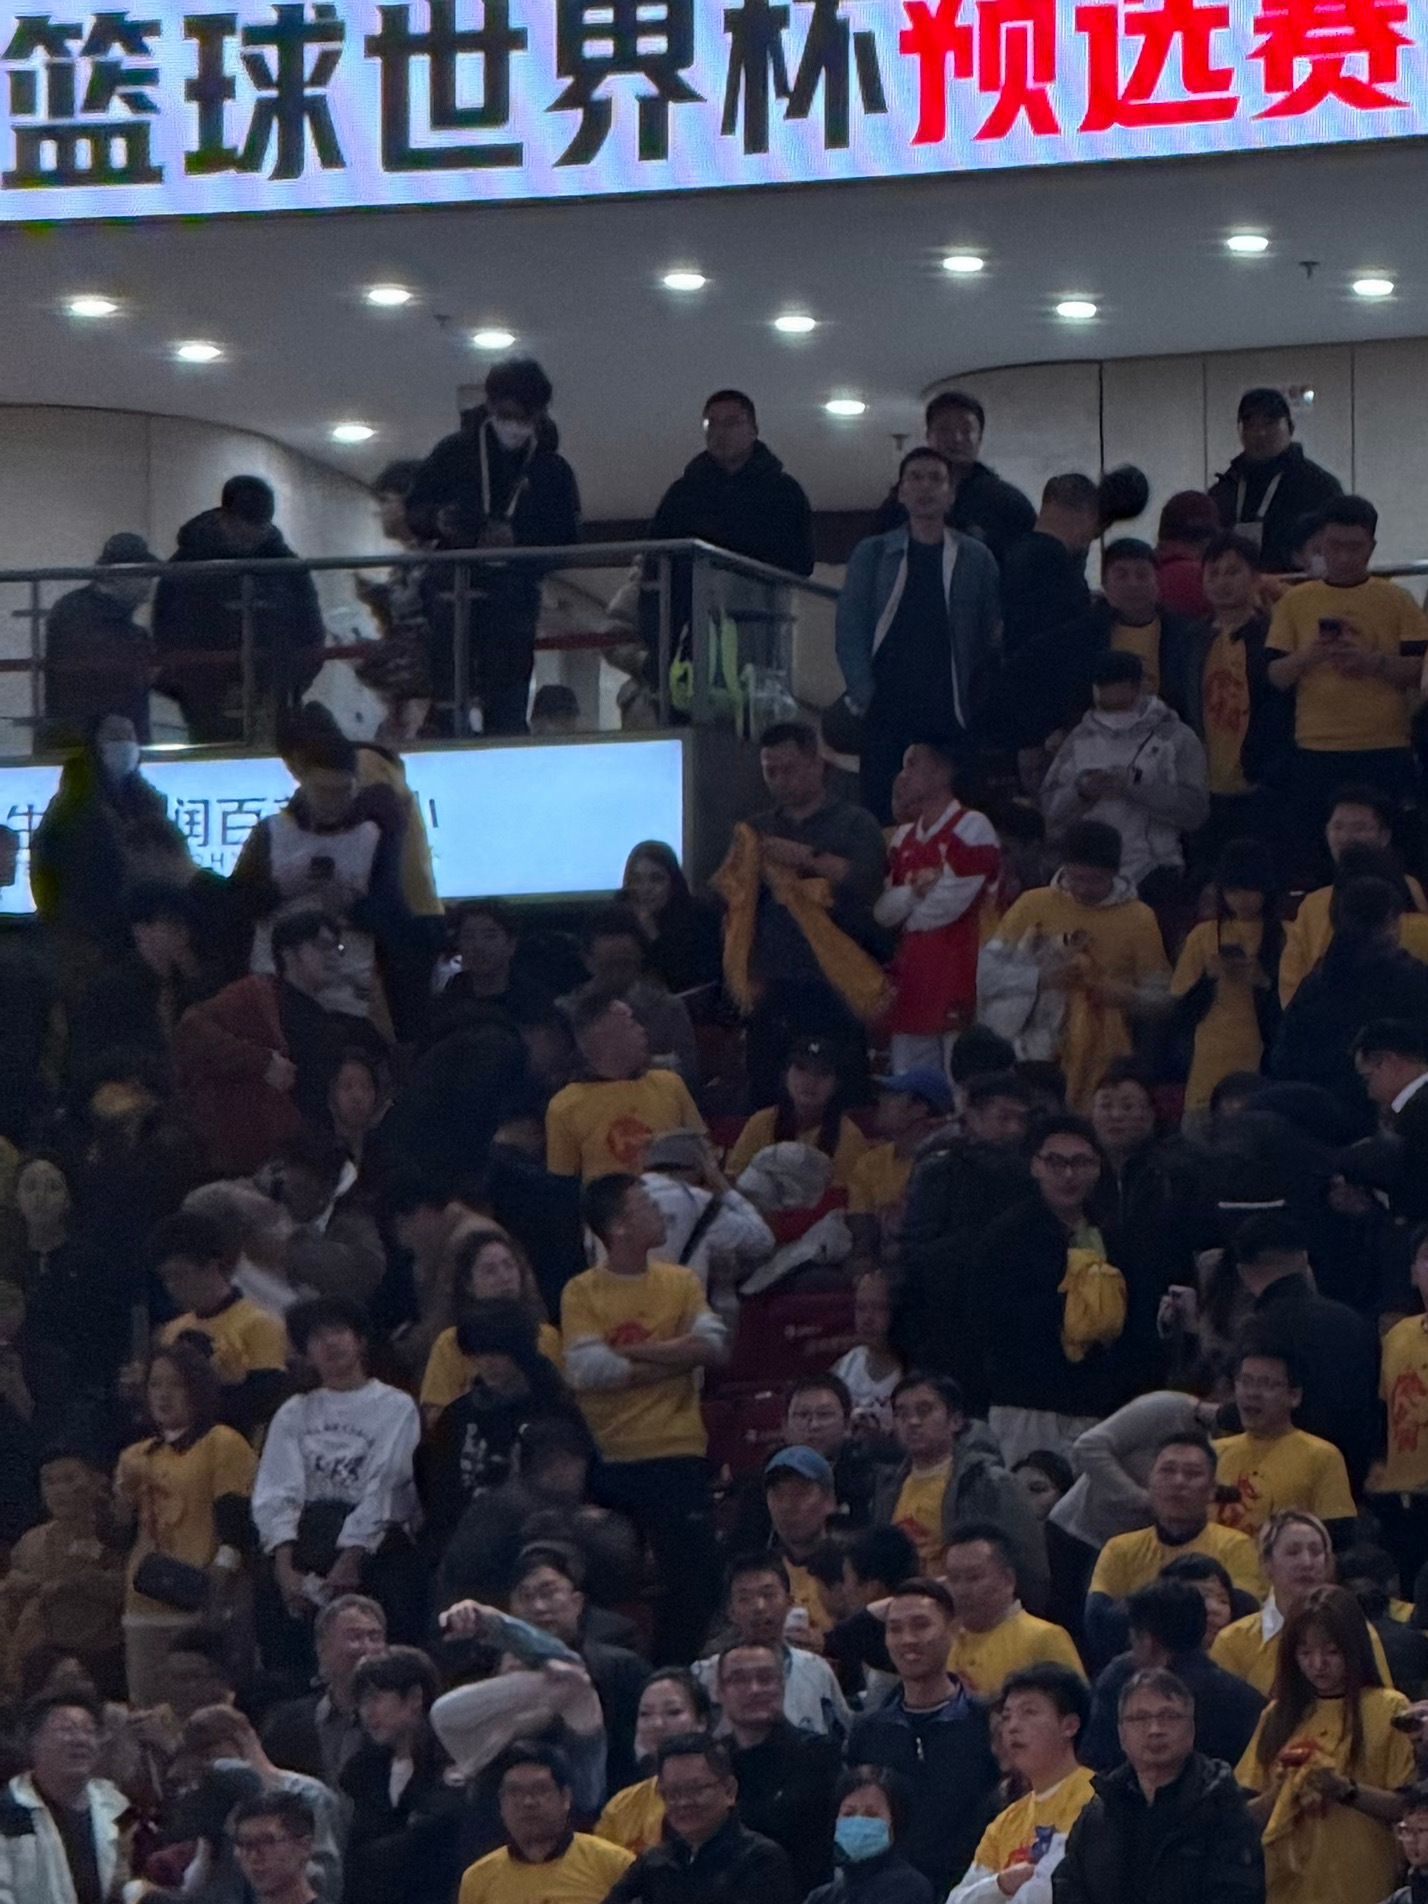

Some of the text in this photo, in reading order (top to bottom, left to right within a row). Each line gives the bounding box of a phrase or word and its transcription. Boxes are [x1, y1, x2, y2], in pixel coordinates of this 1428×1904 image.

[2, 0, 1411, 188] 篮球世界杯预选赛
